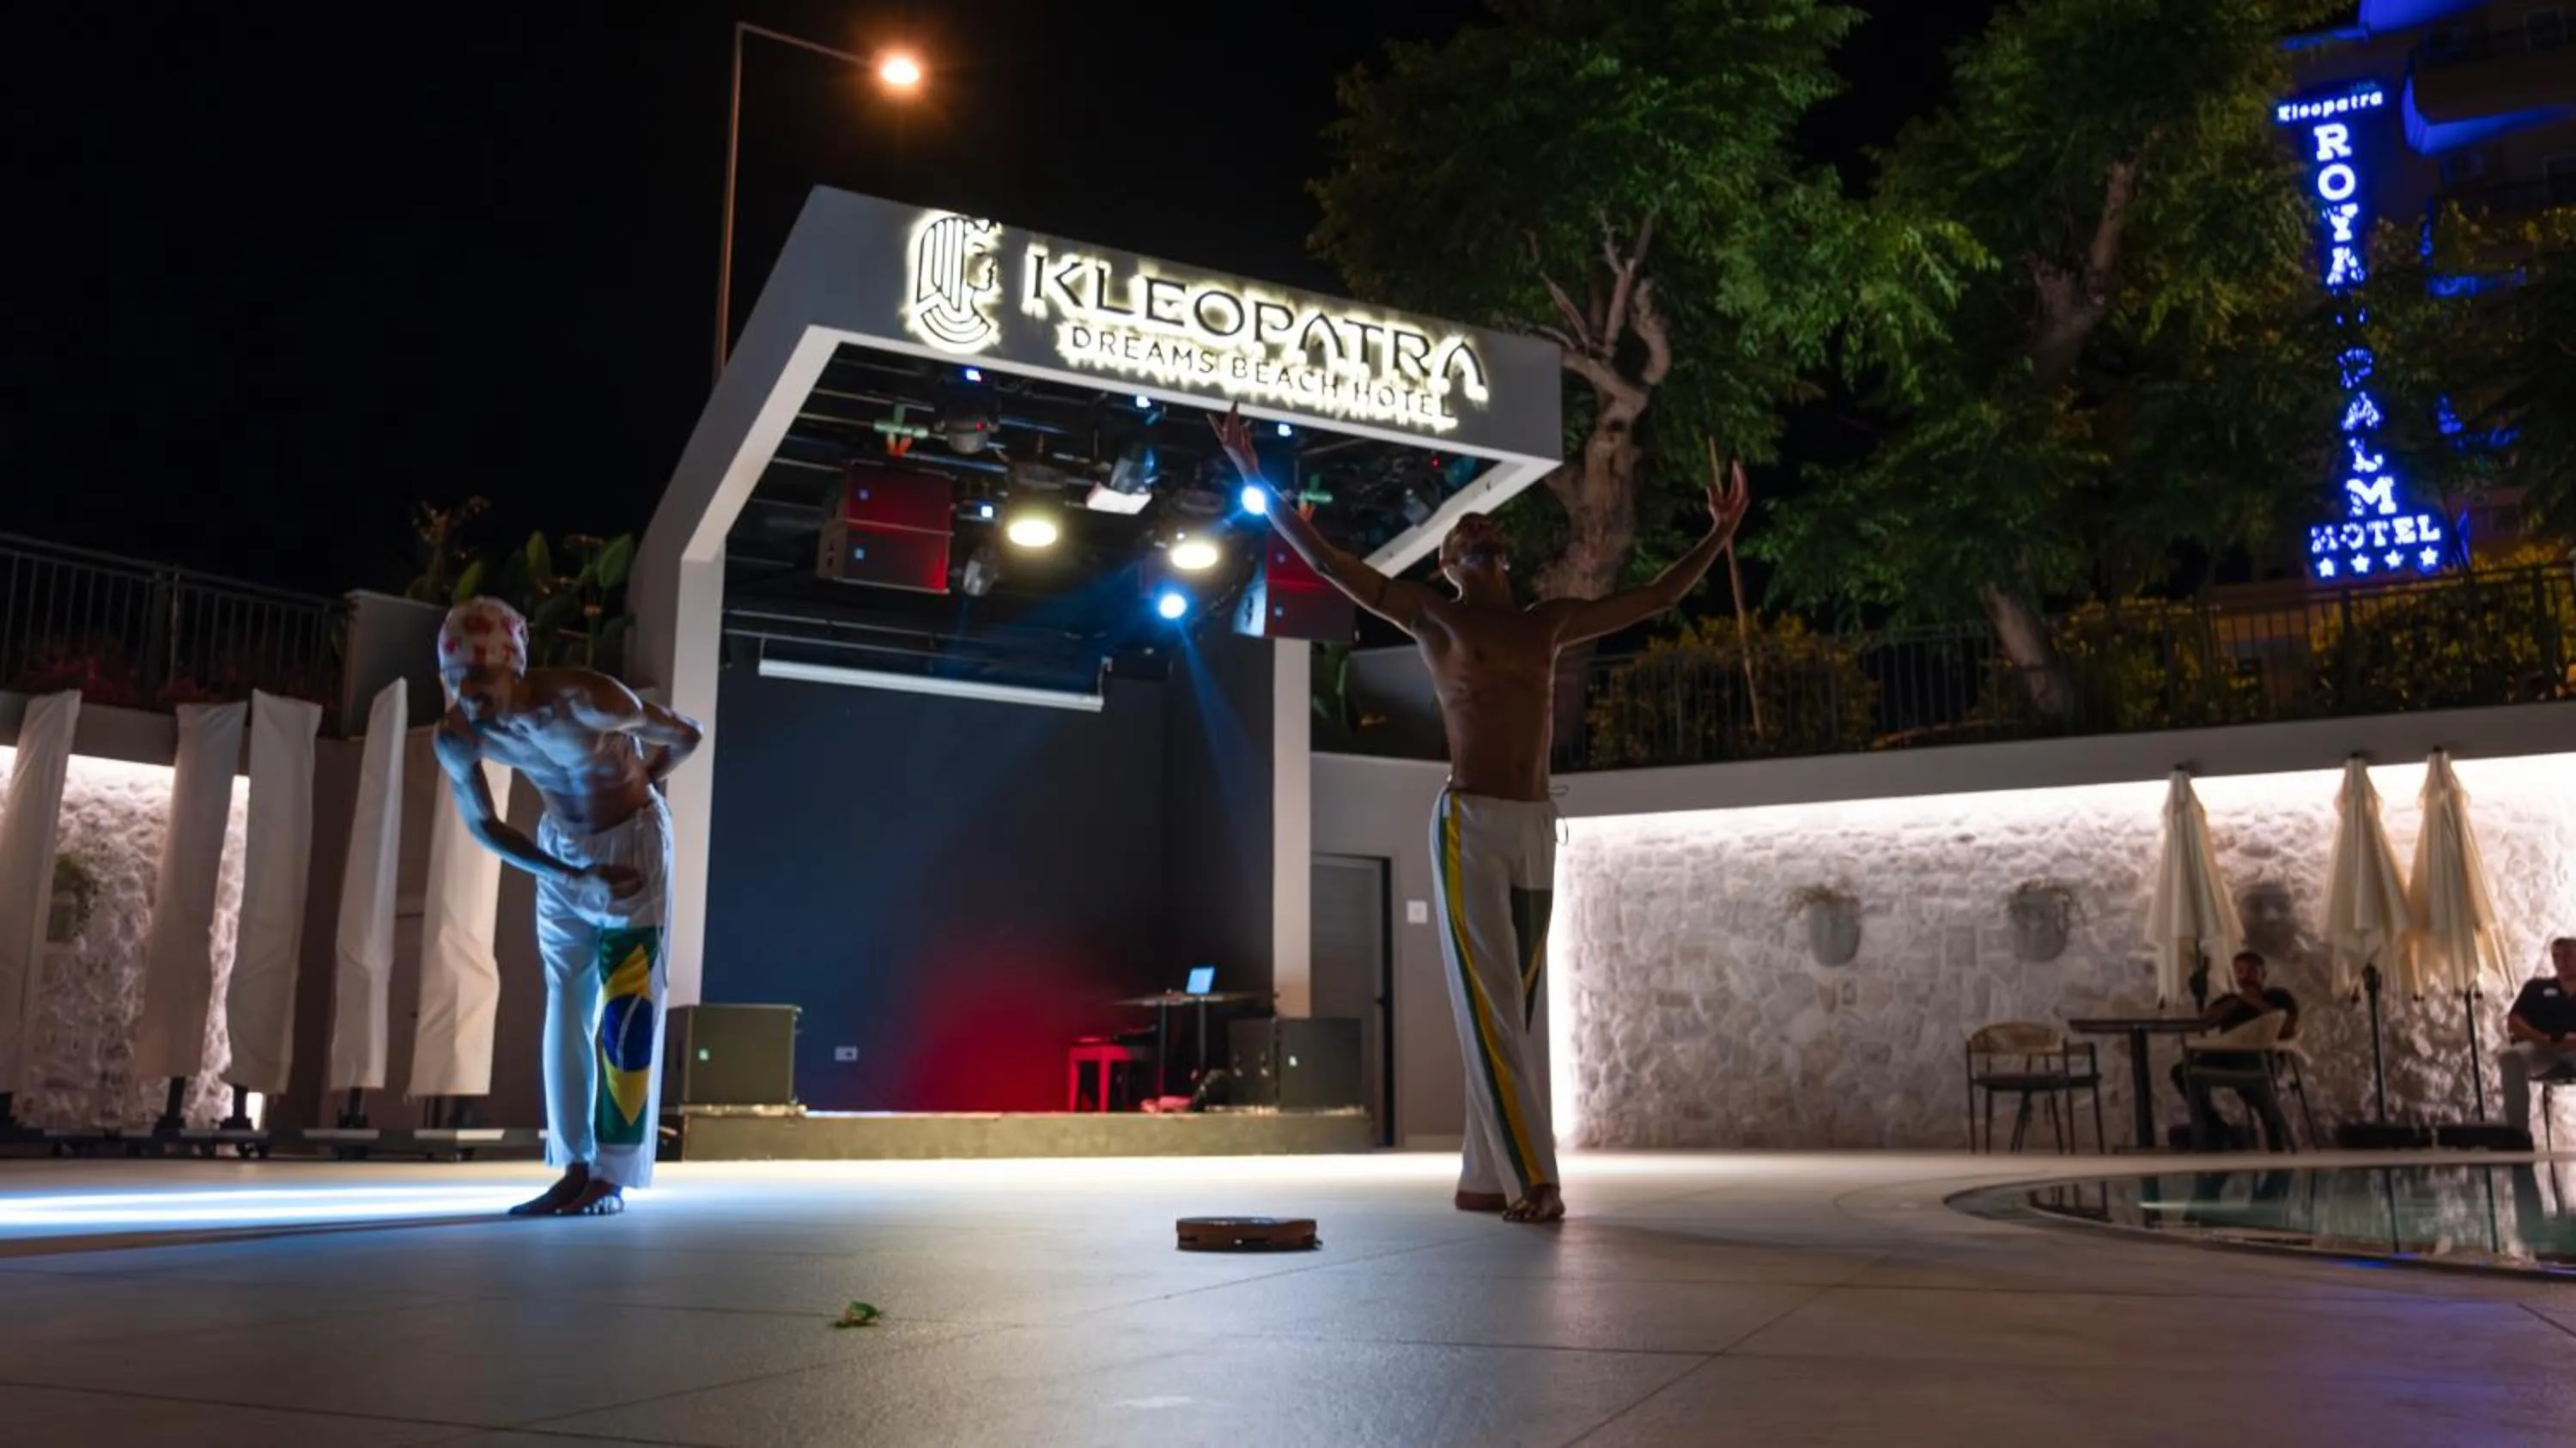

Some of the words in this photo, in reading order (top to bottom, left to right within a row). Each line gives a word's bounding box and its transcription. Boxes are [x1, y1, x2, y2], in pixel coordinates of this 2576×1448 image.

[2277, 91, 2384, 122] Kleopatra
[1033, 253, 1485, 386] KLEOPATRA
[1073, 325, 1216, 374] DREAMS
[1232, 356, 1338, 398] BEACH
[1354, 381, 1455, 418] HOTEL
[2311, 514, 2441, 554] HOTEL
